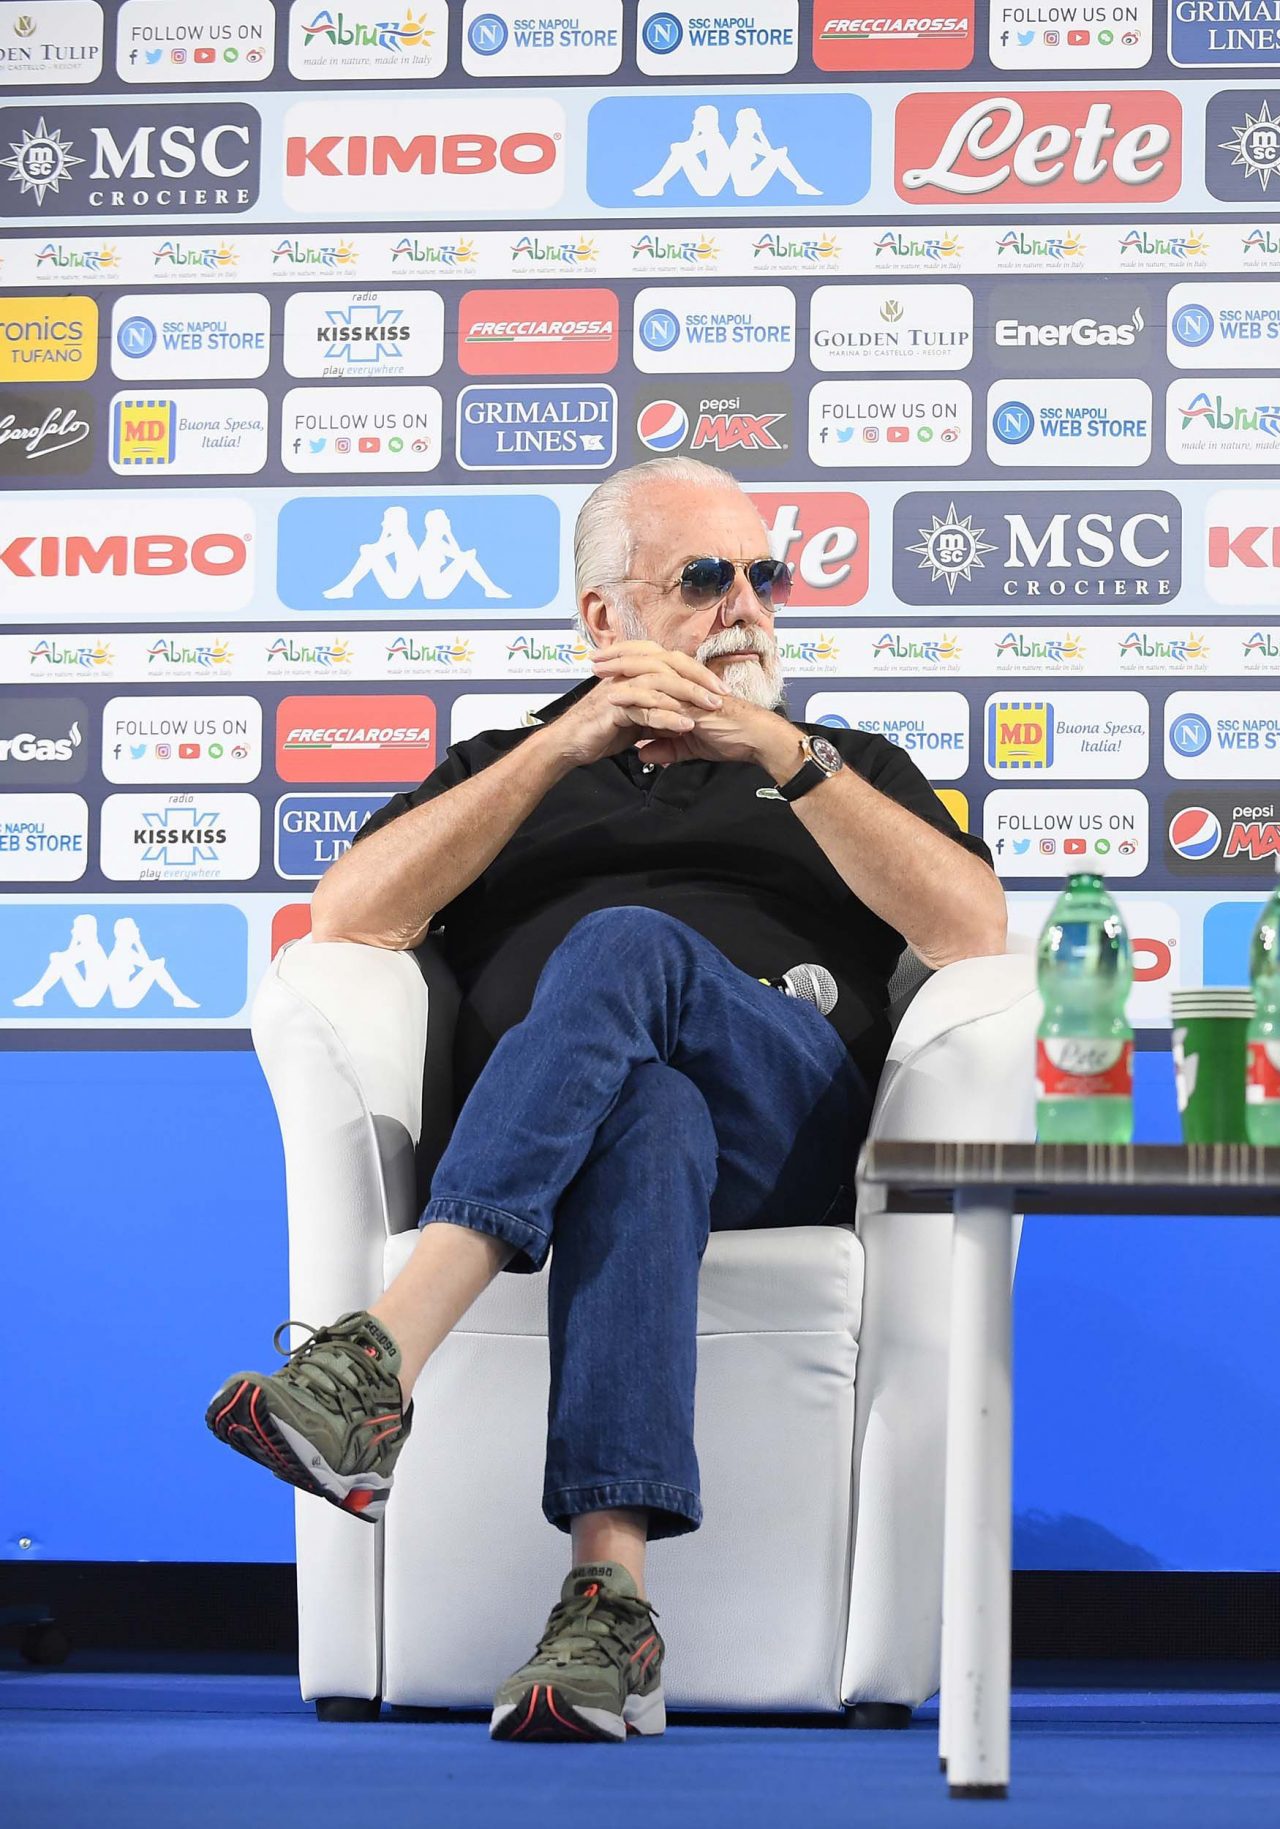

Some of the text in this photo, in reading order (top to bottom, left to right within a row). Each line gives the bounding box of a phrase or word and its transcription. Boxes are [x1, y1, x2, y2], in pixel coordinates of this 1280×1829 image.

[513, 18, 579, 30] SSC NAPOLI
[823, 18, 968, 33] FRECCIAROSSA
[132, 25, 262, 41] FOLLOW US ON
[514, 30, 617, 47] WEB STORE
[303, 56, 327, 65] made
[341, 57, 370, 65] nature,
[375, 55, 398, 64] made
[412, 55, 432, 64] Italy
[89, 125, 249, 179] MSC
[902, 97, 1171, 196] Lete
[286, 132, 556, 177] KIMBO
[89, 189, 249, 206] CROCIERE
[353, 293, 377, 301] radio
[686, 314, 751, 326] SSC NAPOLI
[469, 321, 612, 336] FRECCIAROSSA
[686, 326, 790, 343] WEB STORE
[995, 319, 1135, 346] EnerGas
[814, 330, 969, 347] GOLDEN TULIP
[323, 366, 344, 376] play
[347, 365, 404, 375] everywhere
[700, 397, 740, 412] pepsi
[465, 401, 609, 424] GRIMALDI
[1040, 408, 1107, 419] SSC NAPOLI
[179, 417, 264, 433] Buona Spesa,
[295, 414, 427, 430] FOLLOW US ON
[1040, 420, 1147, 437] WEB STORE
[125, 420, 166, 442] MD
[690, 414, 787, 451] MAX
[201, 435, 241, 448] Italia!
[496, 430, 577, 452] LINES
[1181, 440, 1206, 450] made
[1208, 442, 1217, 450] in
[1220, 442, 1252, 450] nature,
[1255, 440, 1280, 450] made
[1004, 513, 1169, 567] MSC
[1004, 578, 1170, 595] CROCIERE
[116, 720, 247, 735] FOLLOW US ON
[1056, 721, 1145, 736] Buona Spesa,
[1217, 720, 1239, 731] SSC
[286, 727, 430, 742] FRECCIAROSSA
[1000, 722, 1043, 745] MD
[1217, 732, 1259, 749] WEB
[1081, 739, 1122, 752] Italia!
[168, 793, 193, 803] radio
[1233, 805, 1273, 820] pepsi
[998, 815, 1134, 830] FOLLOW US ON
[140, 868, 161, 880] play
[163, 868, 220, 879] everywhere
